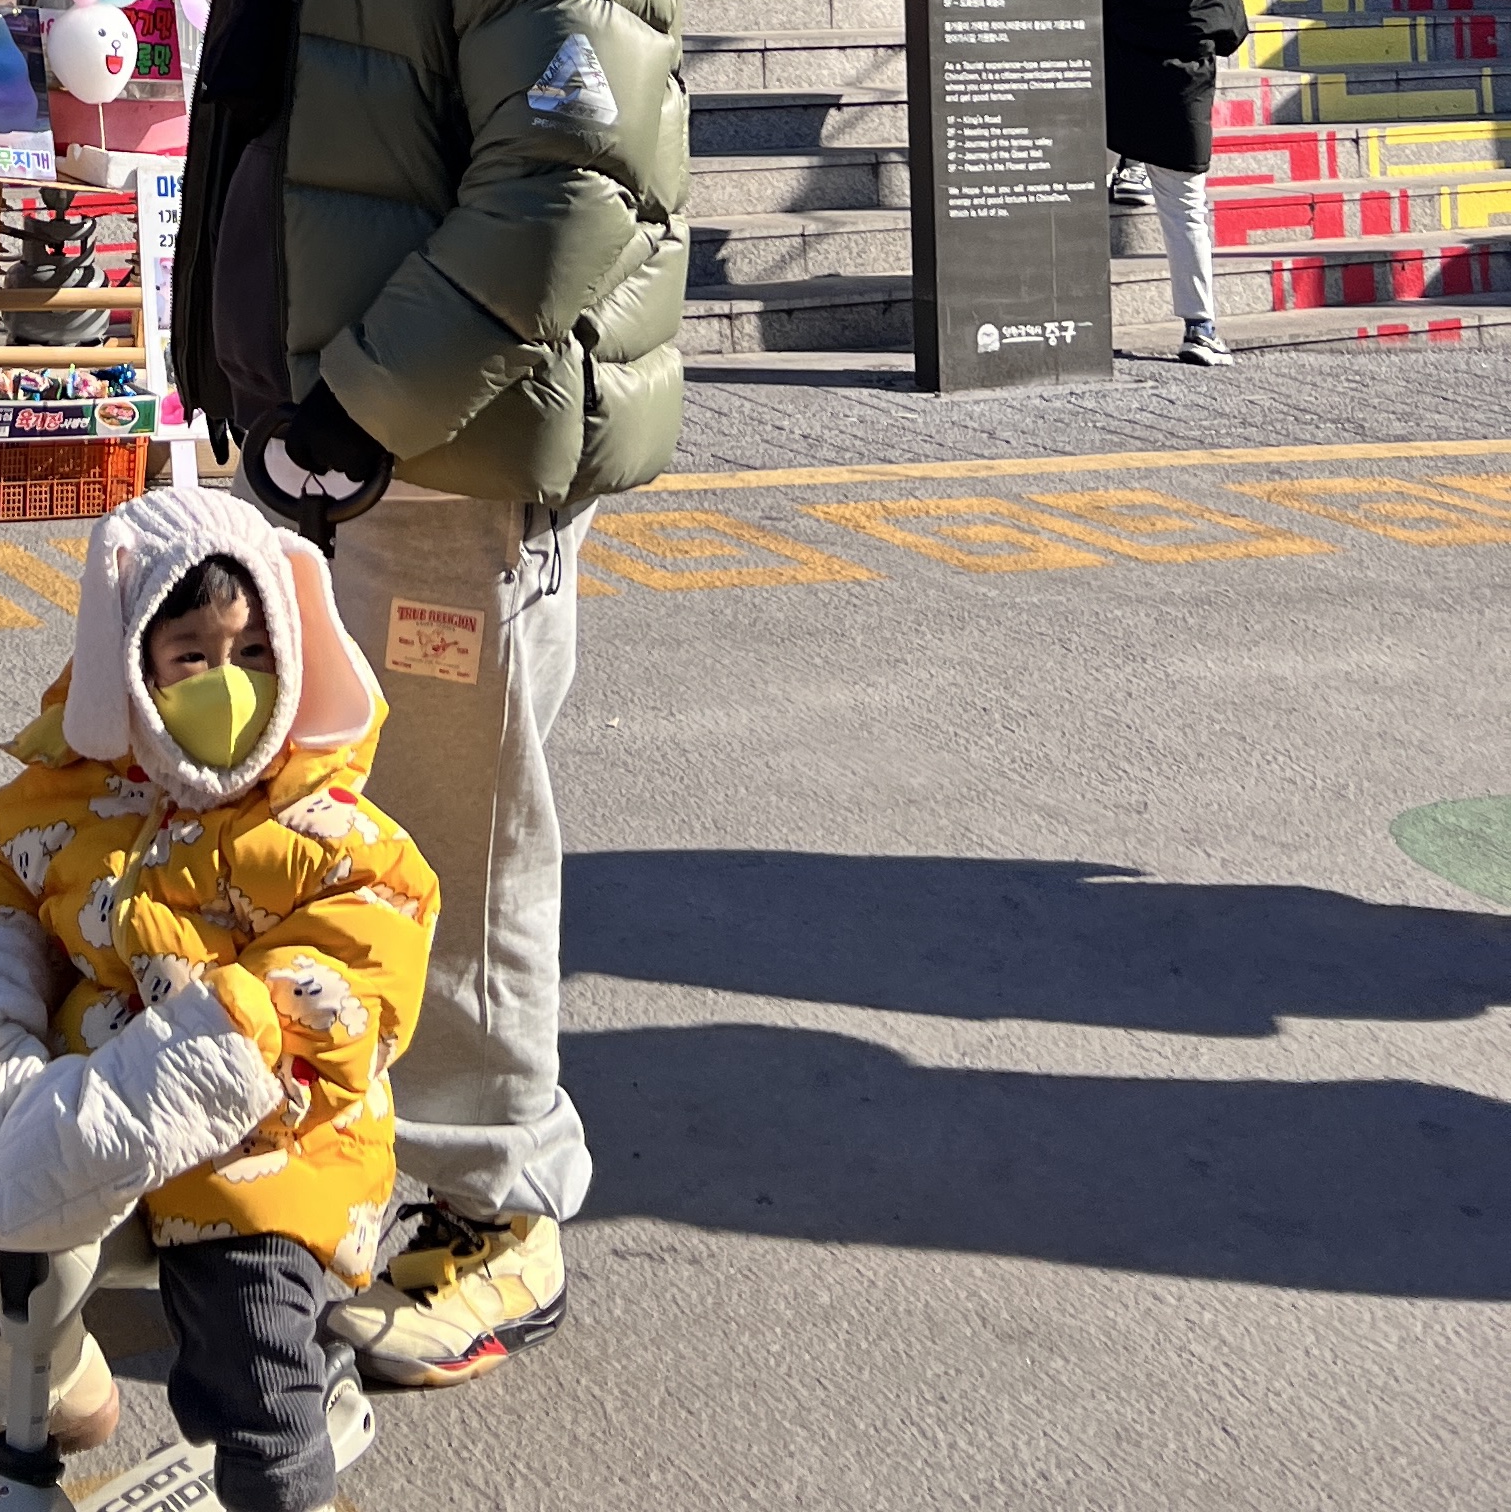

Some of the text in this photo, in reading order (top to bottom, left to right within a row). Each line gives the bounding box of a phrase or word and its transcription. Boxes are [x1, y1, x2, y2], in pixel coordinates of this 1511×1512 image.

[122, 7, 174, 40] 기맛
[1043, 320, 1076, 346] 중구
[15, 408, 64, 431] 육개장
[397, 605, 427, 622] TRUE
[427, 609, 477, 634] RELIGION
